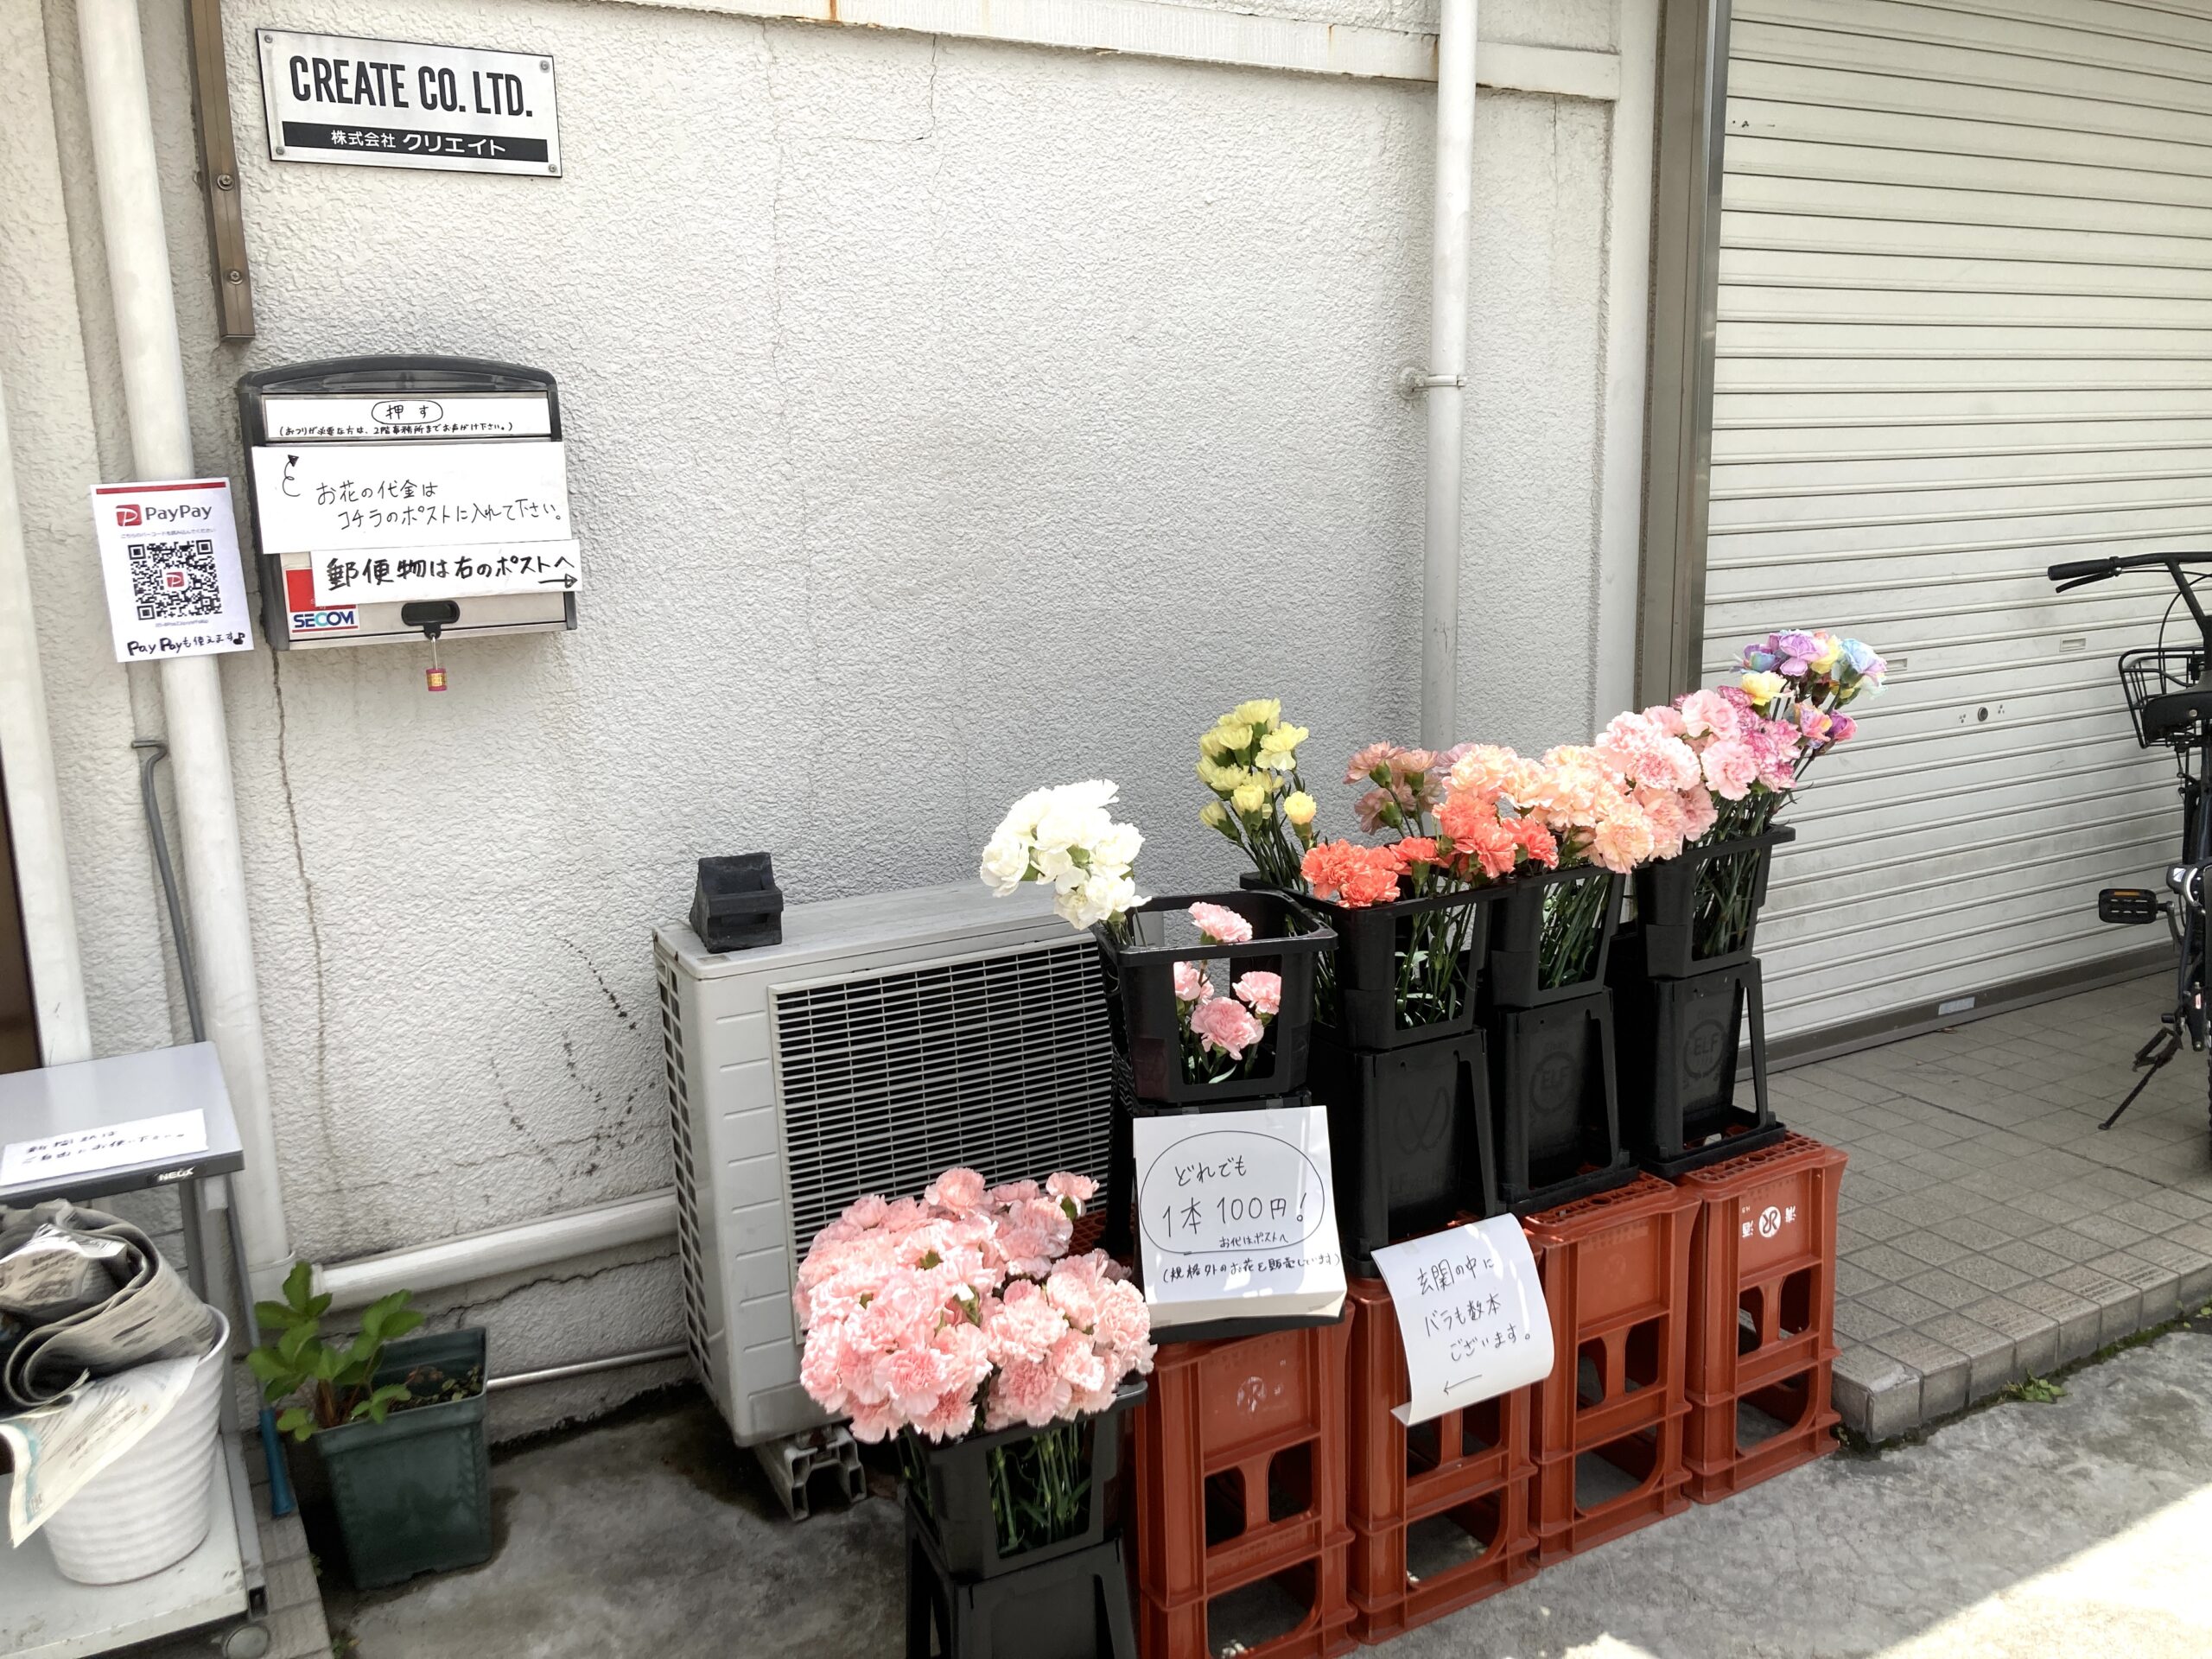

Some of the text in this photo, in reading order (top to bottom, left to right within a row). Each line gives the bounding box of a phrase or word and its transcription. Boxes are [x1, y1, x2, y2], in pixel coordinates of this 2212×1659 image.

[289, 55, 532, 117] CREATE CO. LTD.
[331, 130, 505, 156] 株式会社 クリエイト
[316, 480, 438, 505] お花の代金は
[145, 505, 212, 522] PayPay
[338, 499, 562, 530] コチラのポストに入れて下さい。
[327, 556, 575, 591] 郵便物は右のポストへ
[293, 611, 355, 629] SECOM
[1175, 1155, 1247, 1186] どれでも
[1417, 1255, 1494, 1295] 玄関の中に
[1425, 1293, 1501, 1337] バラも数本
[1450, 1323, 1531, 1362] ございます。
